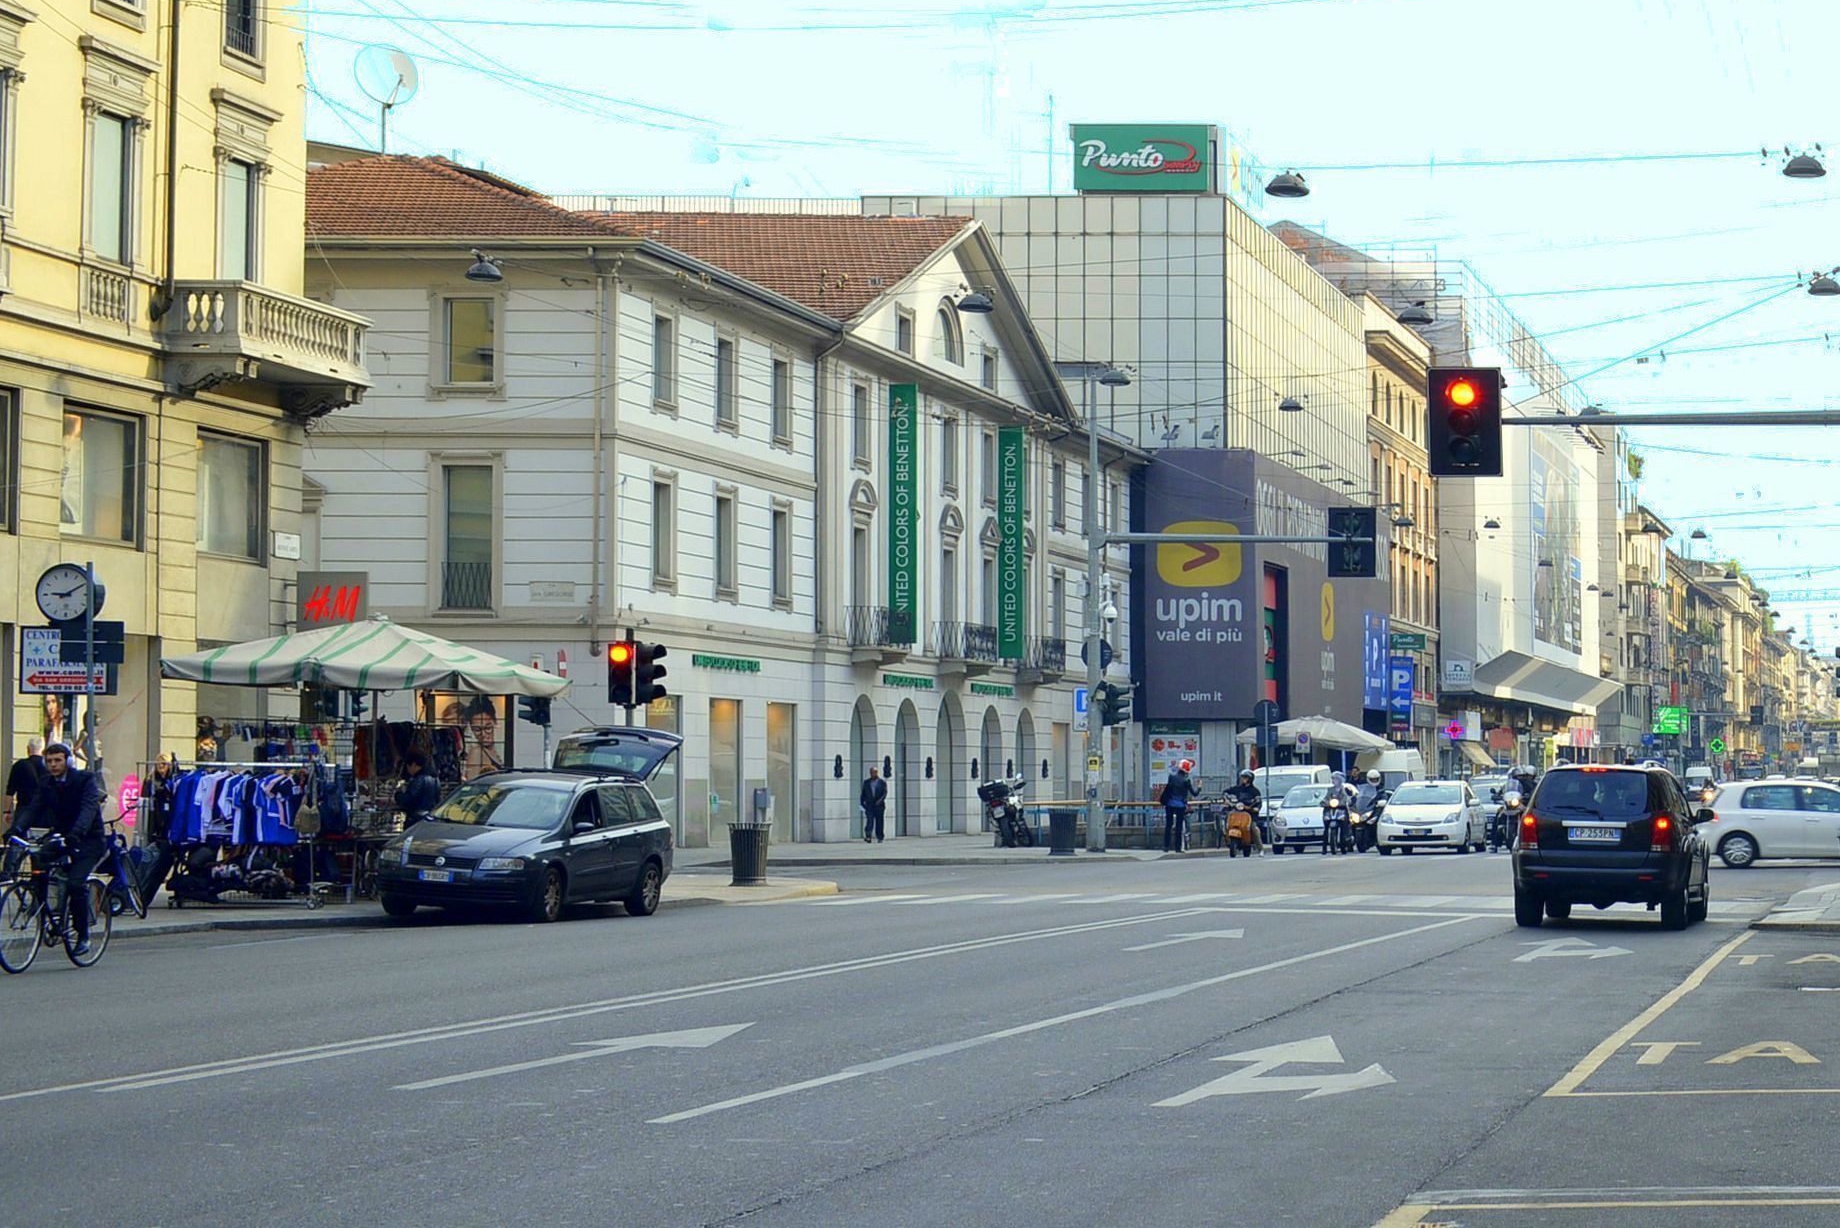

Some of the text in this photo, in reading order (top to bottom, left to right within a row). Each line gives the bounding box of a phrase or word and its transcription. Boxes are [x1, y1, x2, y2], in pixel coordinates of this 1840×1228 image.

[1079, 139, 1164, 168] Punto
[896, 486, 909, 505] OF
[896, 508, 909, 565] COLORS
[1005, 517, 1016, 535] OF
[1005, 537, 1016, 590] COLORS
[303, 584, 360, 623] H&M
[1005, 593, 1016, 641] UNITED
[1157, 592, 1242, 629] upim
[1157, 628, 1242, 644] vale di più
[1392, 669, 1410, 691] P
